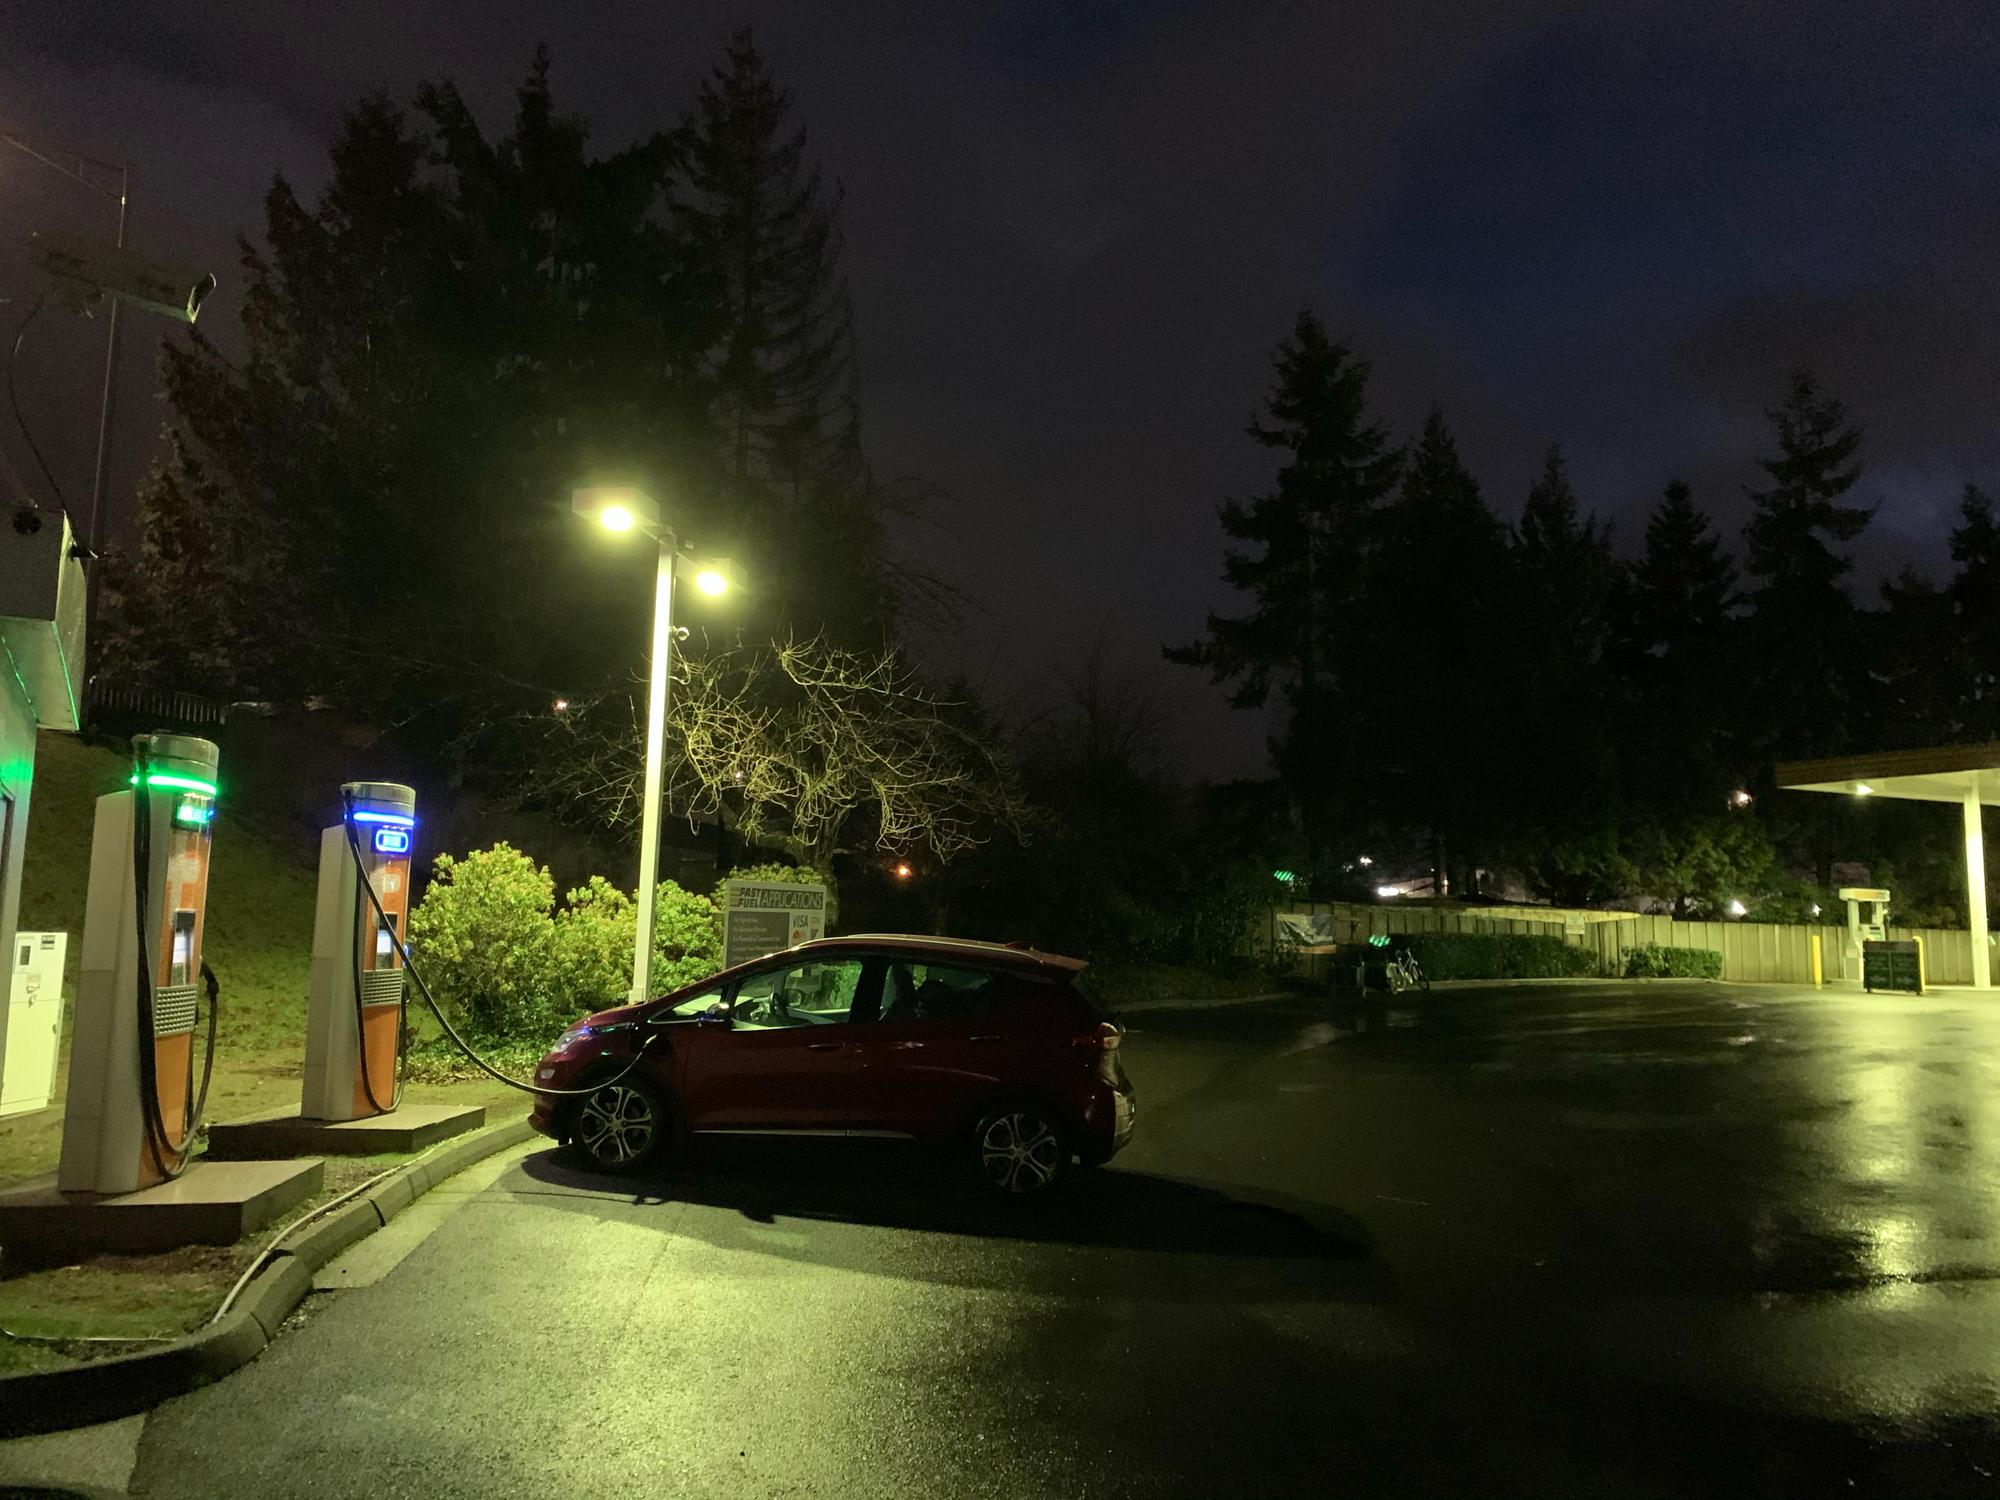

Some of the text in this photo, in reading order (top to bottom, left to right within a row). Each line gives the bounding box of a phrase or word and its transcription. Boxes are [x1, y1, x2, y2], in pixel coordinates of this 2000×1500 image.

[740, 887, 760, 897] FAST
[738, 898, 759, 908] FUEL
[761, 890, 822, 908] APPLICATIONS
[793, 914, 808, 927] VISA
